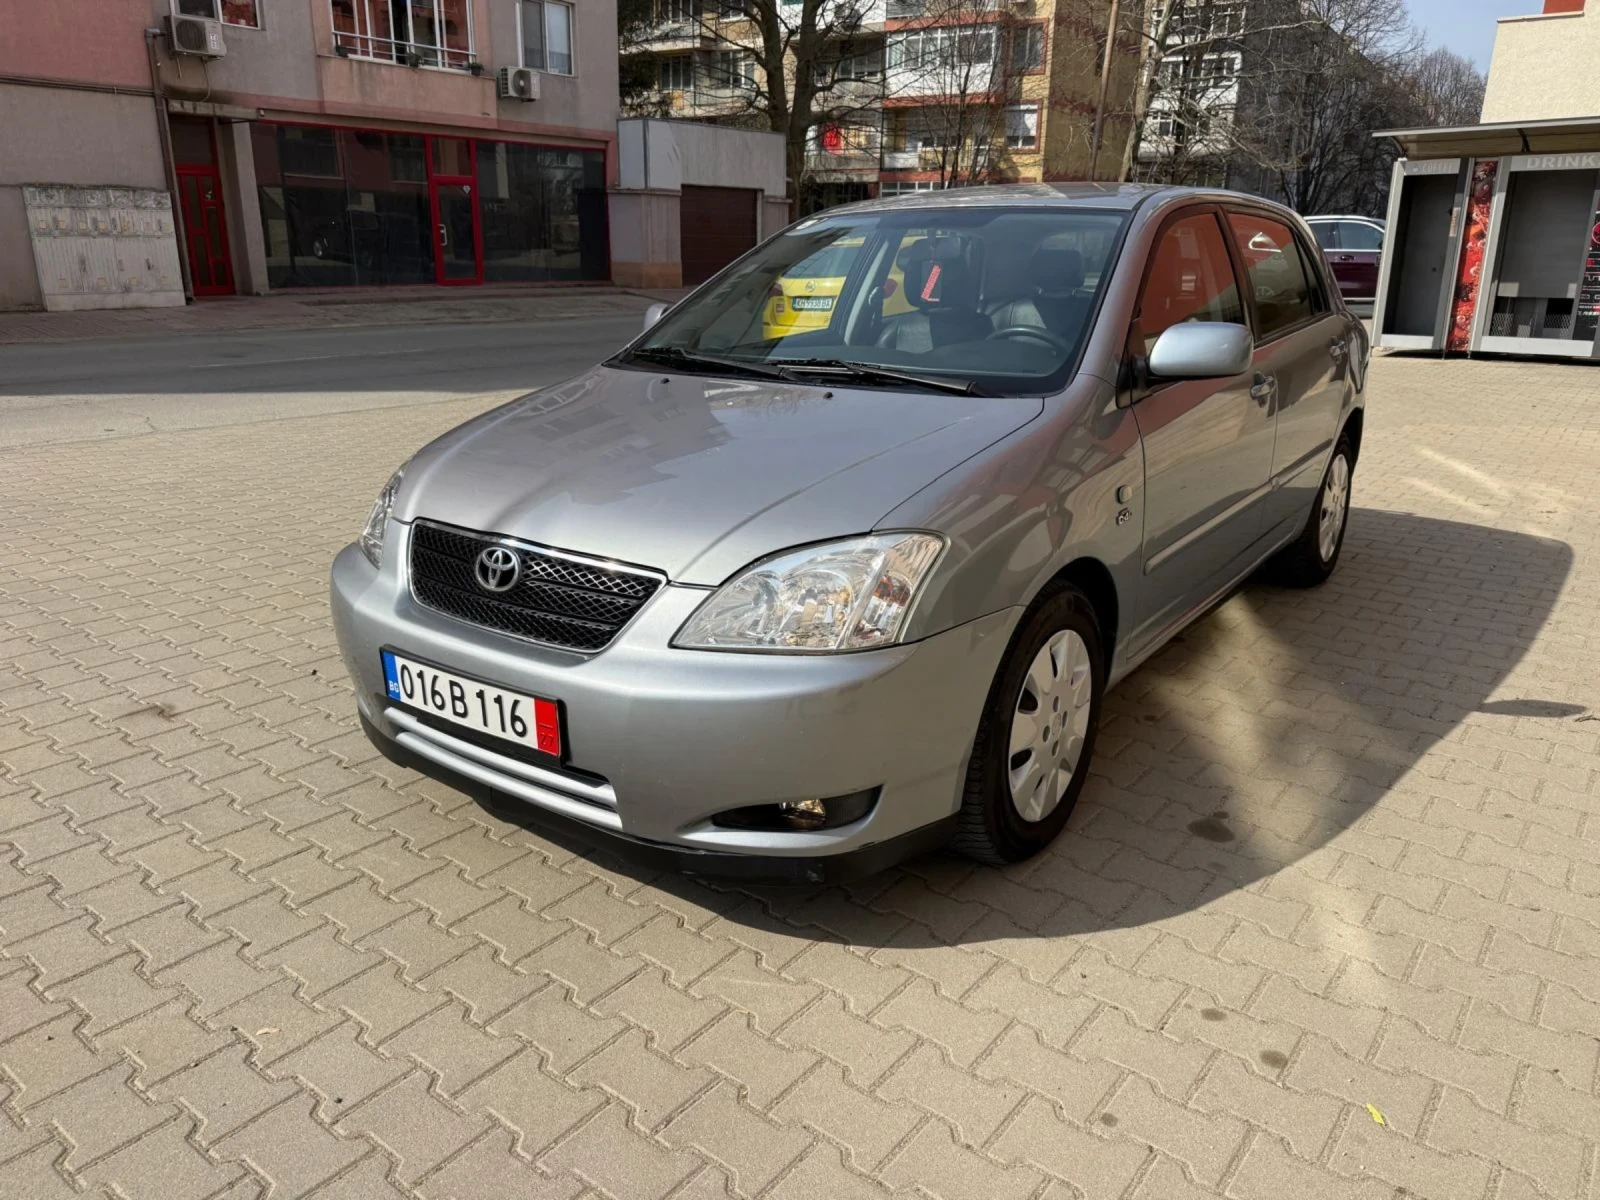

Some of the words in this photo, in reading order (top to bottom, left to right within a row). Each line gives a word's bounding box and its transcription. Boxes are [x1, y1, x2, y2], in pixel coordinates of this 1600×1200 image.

[1526, 154, 1600, 169] DRINK
[389, 680, 399, 693] BG
[400, 664, 528, 738] 016B116
[539, 732, 555, 747] 27
